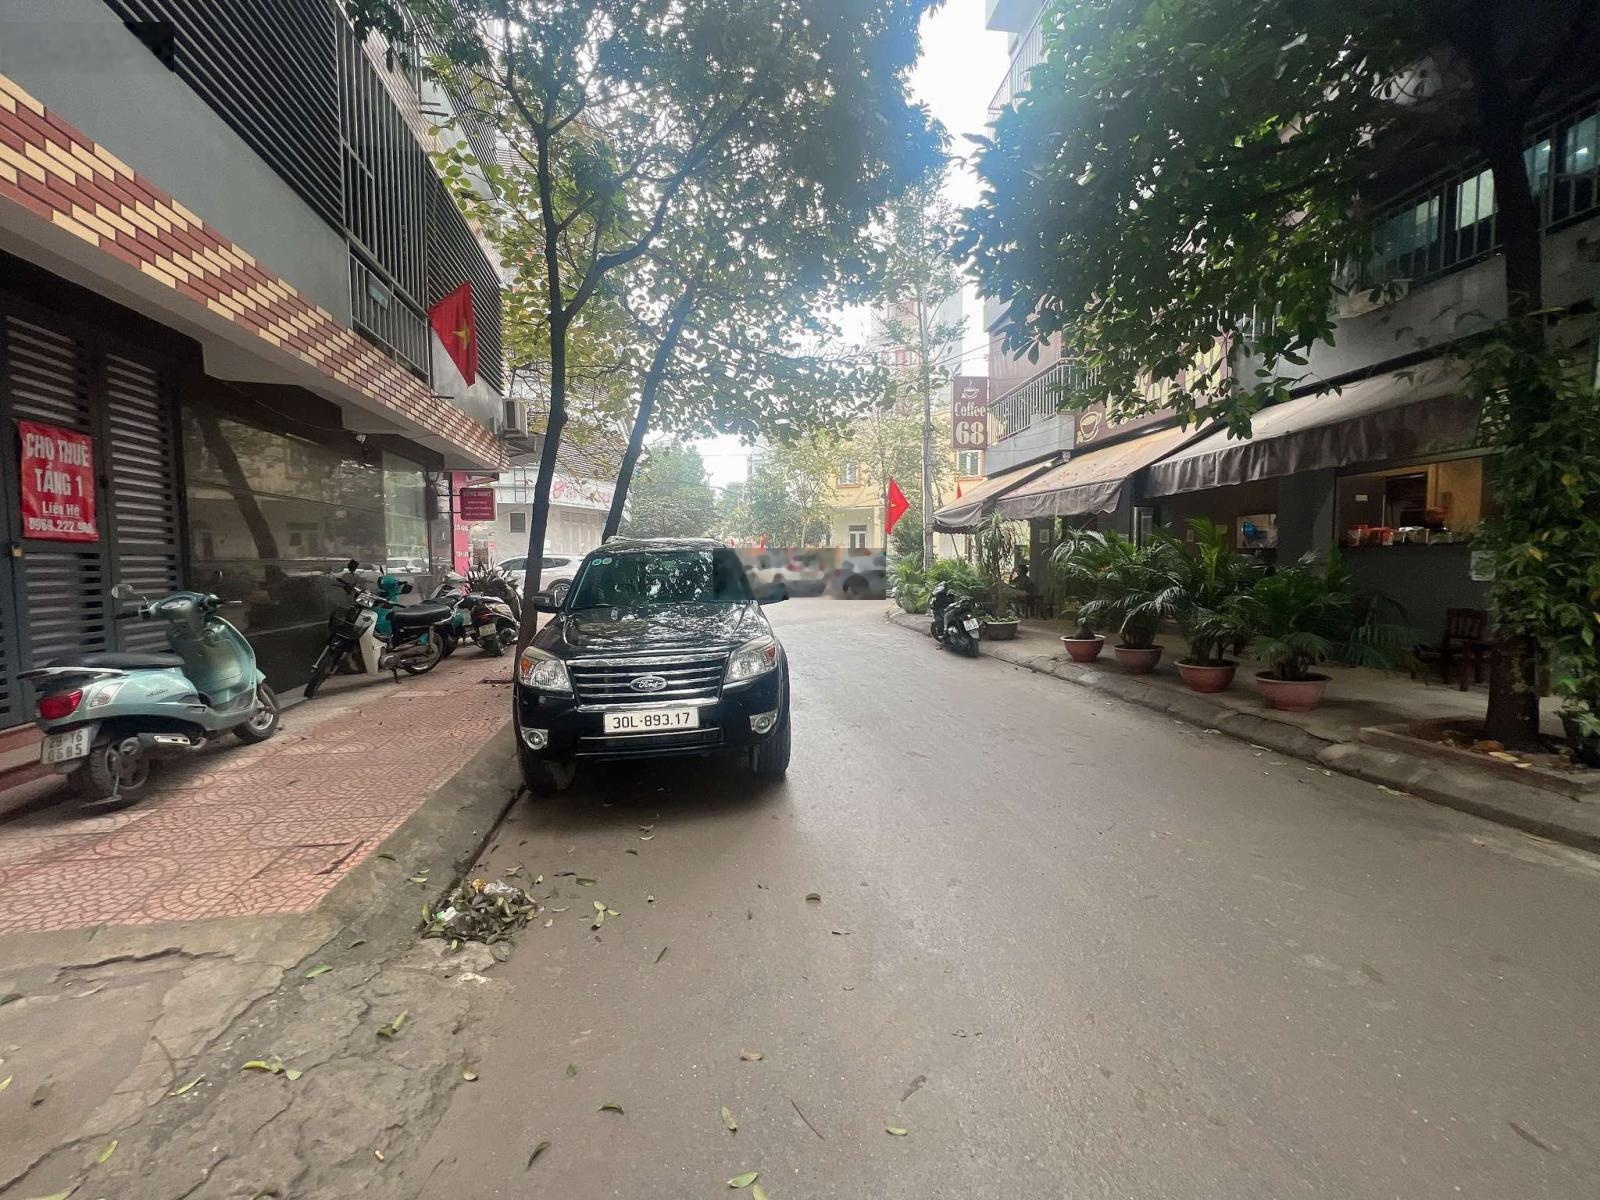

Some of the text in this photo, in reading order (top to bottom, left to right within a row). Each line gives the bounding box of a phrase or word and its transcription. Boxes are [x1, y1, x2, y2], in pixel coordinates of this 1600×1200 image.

[954, 401, 986, 417] Coffee
[955, 421, 985, 445] 68
[26, 433, 55, 461] CHO
[75, 475, 83, 497] 1
[637, 679, 664, 688] Ford
[613, 711, 690, 730] 30L-893.17
